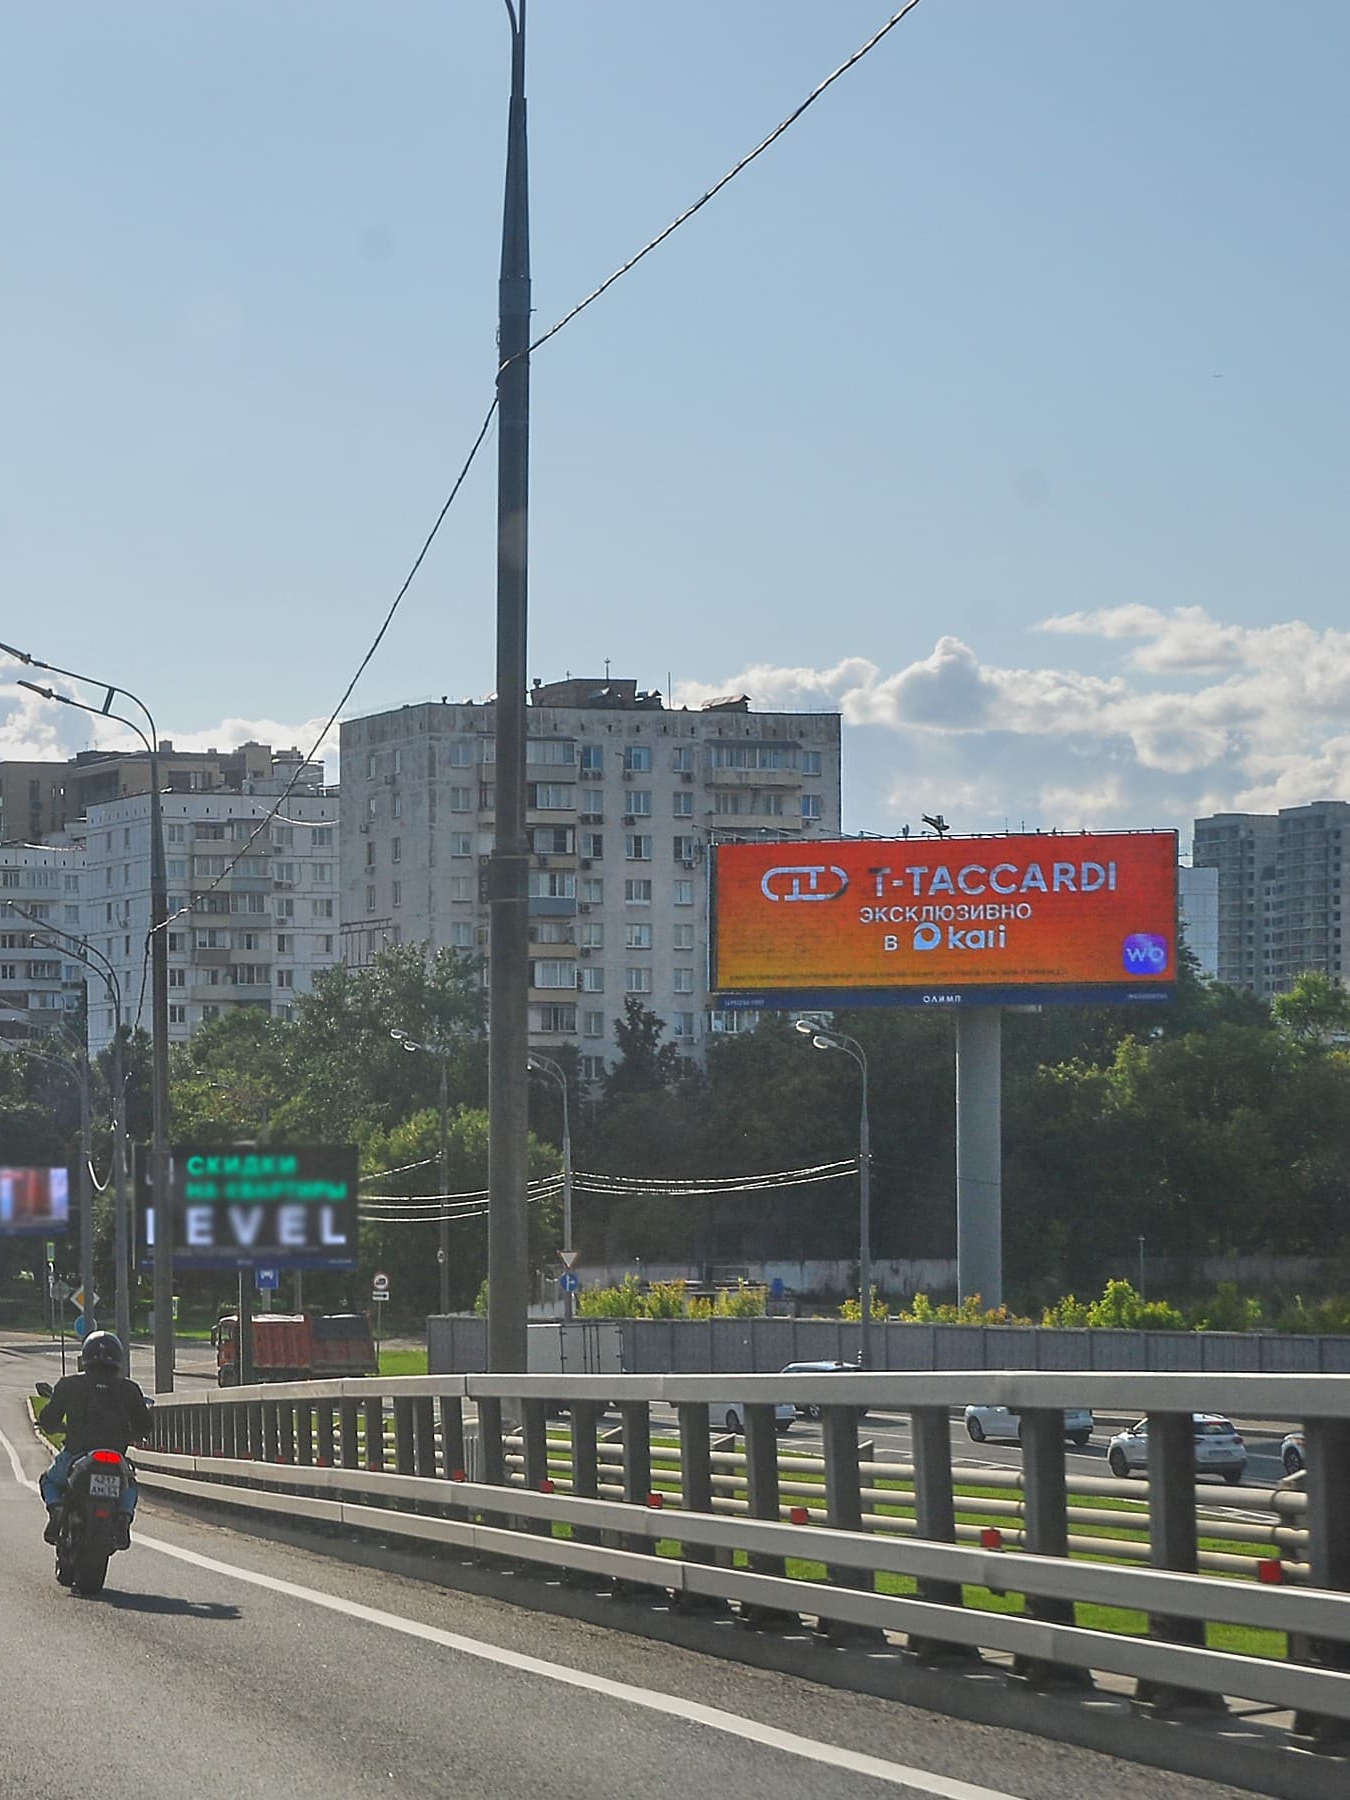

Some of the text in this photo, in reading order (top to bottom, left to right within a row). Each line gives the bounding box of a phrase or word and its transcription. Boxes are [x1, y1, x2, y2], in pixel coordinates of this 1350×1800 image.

[869, 861, 1116, 898] T-TACCARDI
[859, 903, 1032, 924] ЭКСКЛЮЗИВНО
[923, 994, 962, 1004] ОЛИМП
[187, 1155, 298, 1176] СКИДКИ
